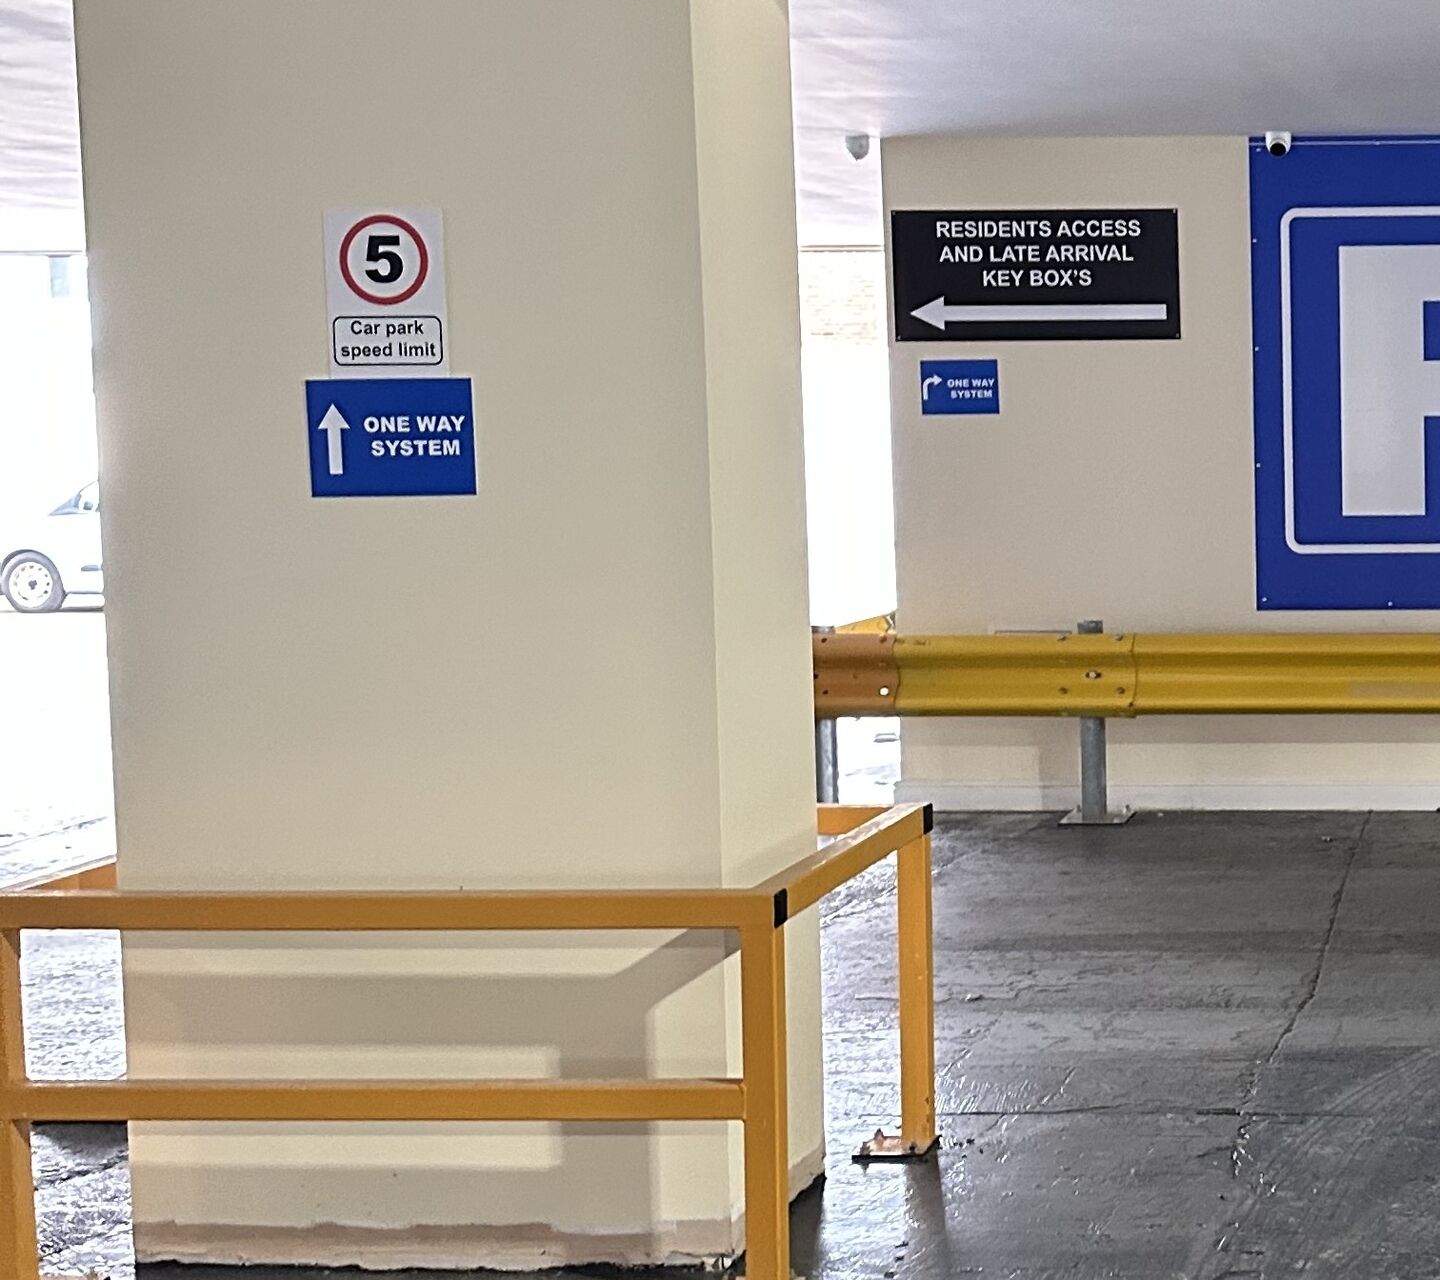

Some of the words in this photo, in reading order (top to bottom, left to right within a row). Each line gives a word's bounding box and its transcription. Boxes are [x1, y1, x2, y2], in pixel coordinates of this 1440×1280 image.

[935, 220, 1051, 238] RESIDENTS
[1056, 219, 1141, 237] ACCESS
[364, 234, 404, 284] 5
[939, 245, 984, 263] AND
[989, 244, 1040, 262] LATE
[1045, 244, 1134, 262] ARRIVAL
[982, 269, 1024, 287] KEY
[1029, 268, 1093, 287] BOX'S
[350, 320, 381, 336] Car
[386, 320, 425, 338] park
[340, 342, 393, 360] speed
[398, 341, 437, 358] limit
[946, 378, 969, 388] ONE
[971, 377, 995, 388] WAY
[950, 389, 993, 400] SYSTEM
[363, 416, 411, 433] ONE
[416, 415, 466, 433] WAY
[370, 439, 461, 457] SYSTEM
